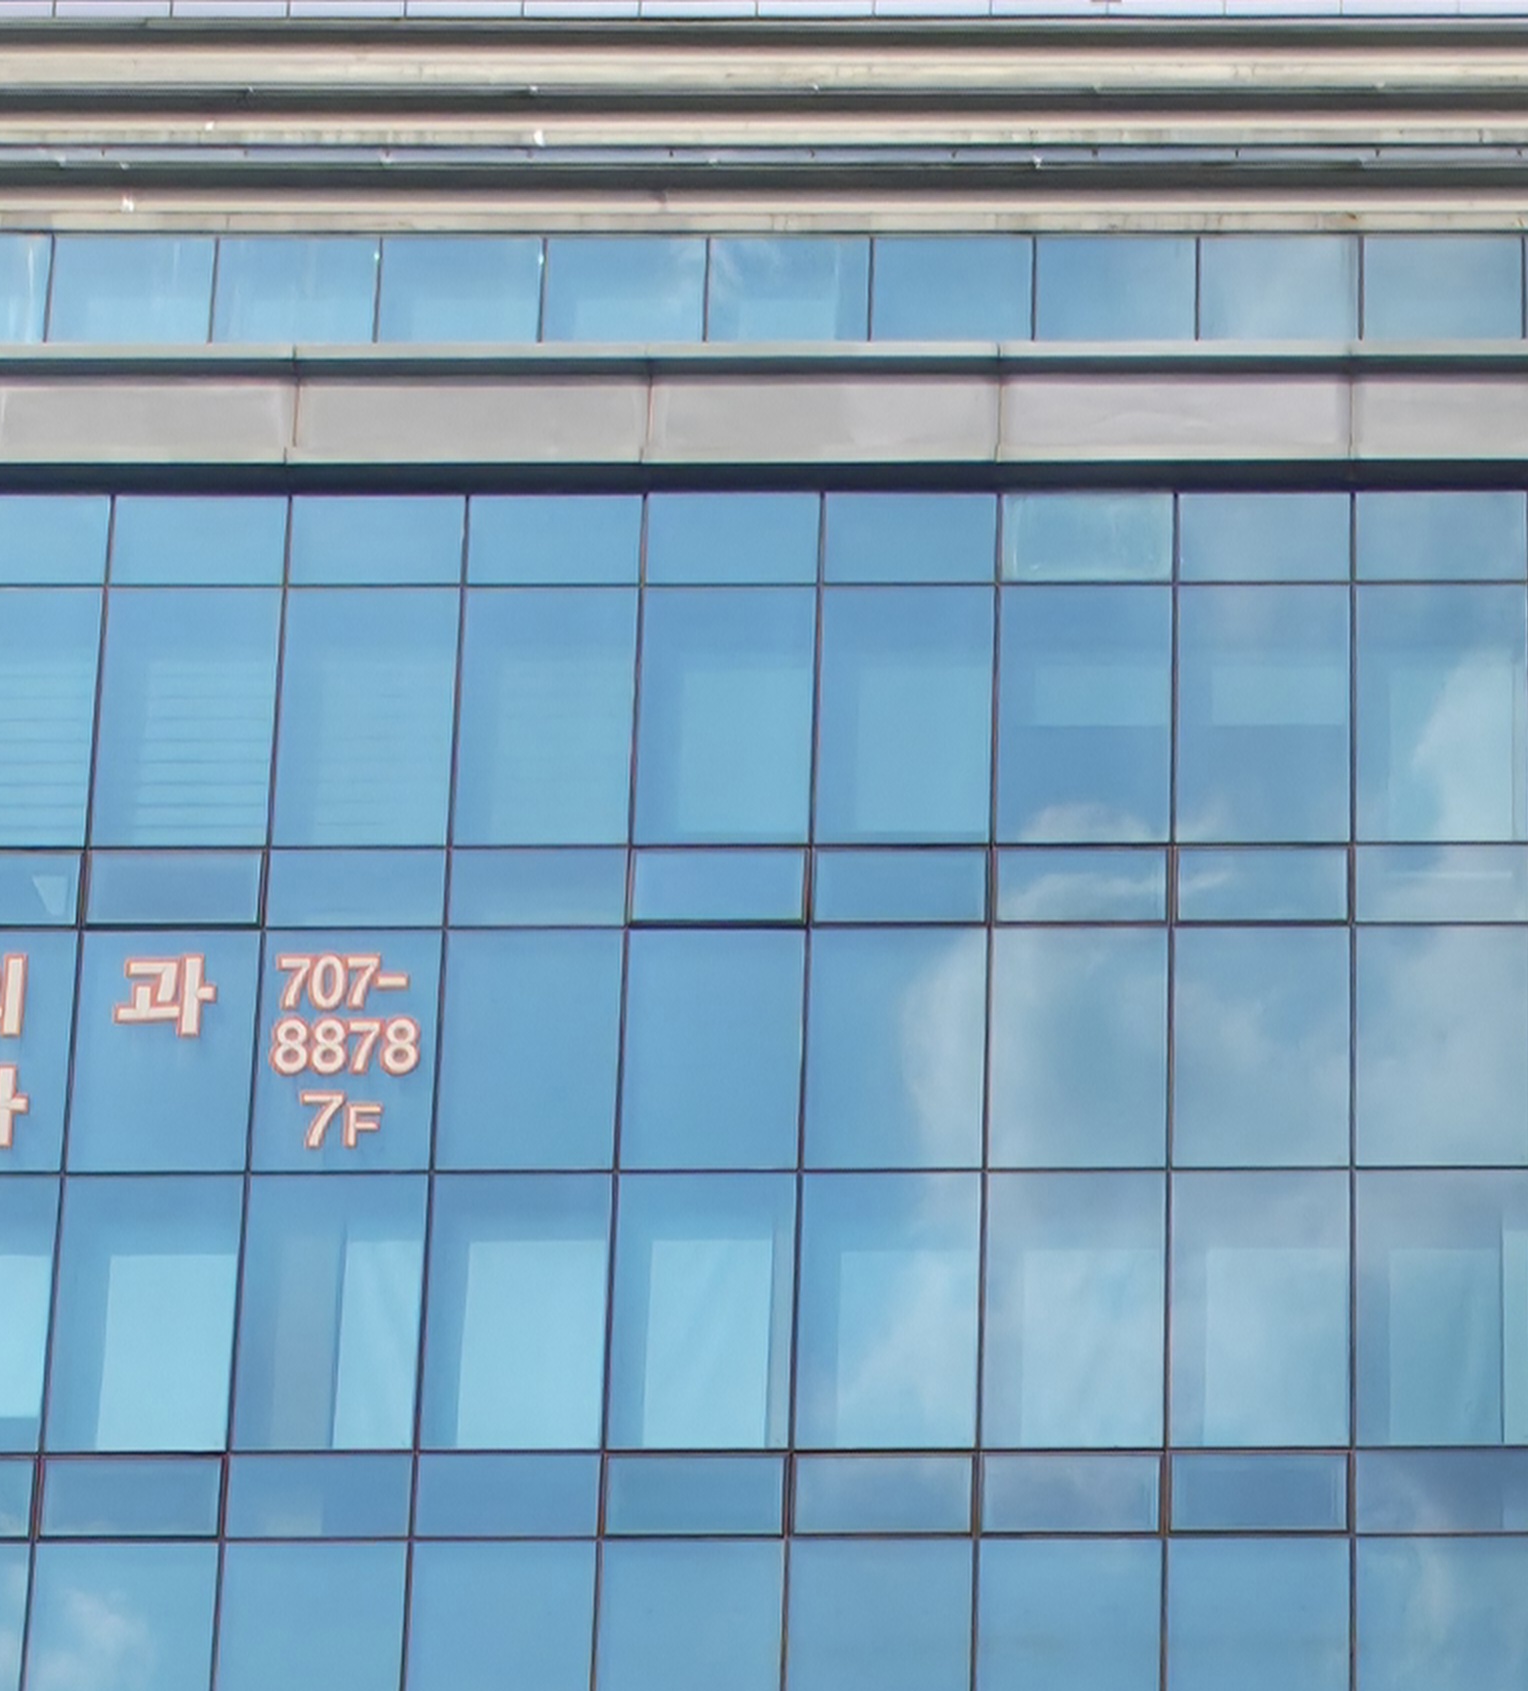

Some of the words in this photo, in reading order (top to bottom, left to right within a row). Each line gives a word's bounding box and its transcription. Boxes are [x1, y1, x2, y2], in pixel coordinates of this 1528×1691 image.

[275, 951, 411, 1012] 707-
[268, 1016, 421, 1078] 8878
[298, 1089, 386, 1150] 7F
